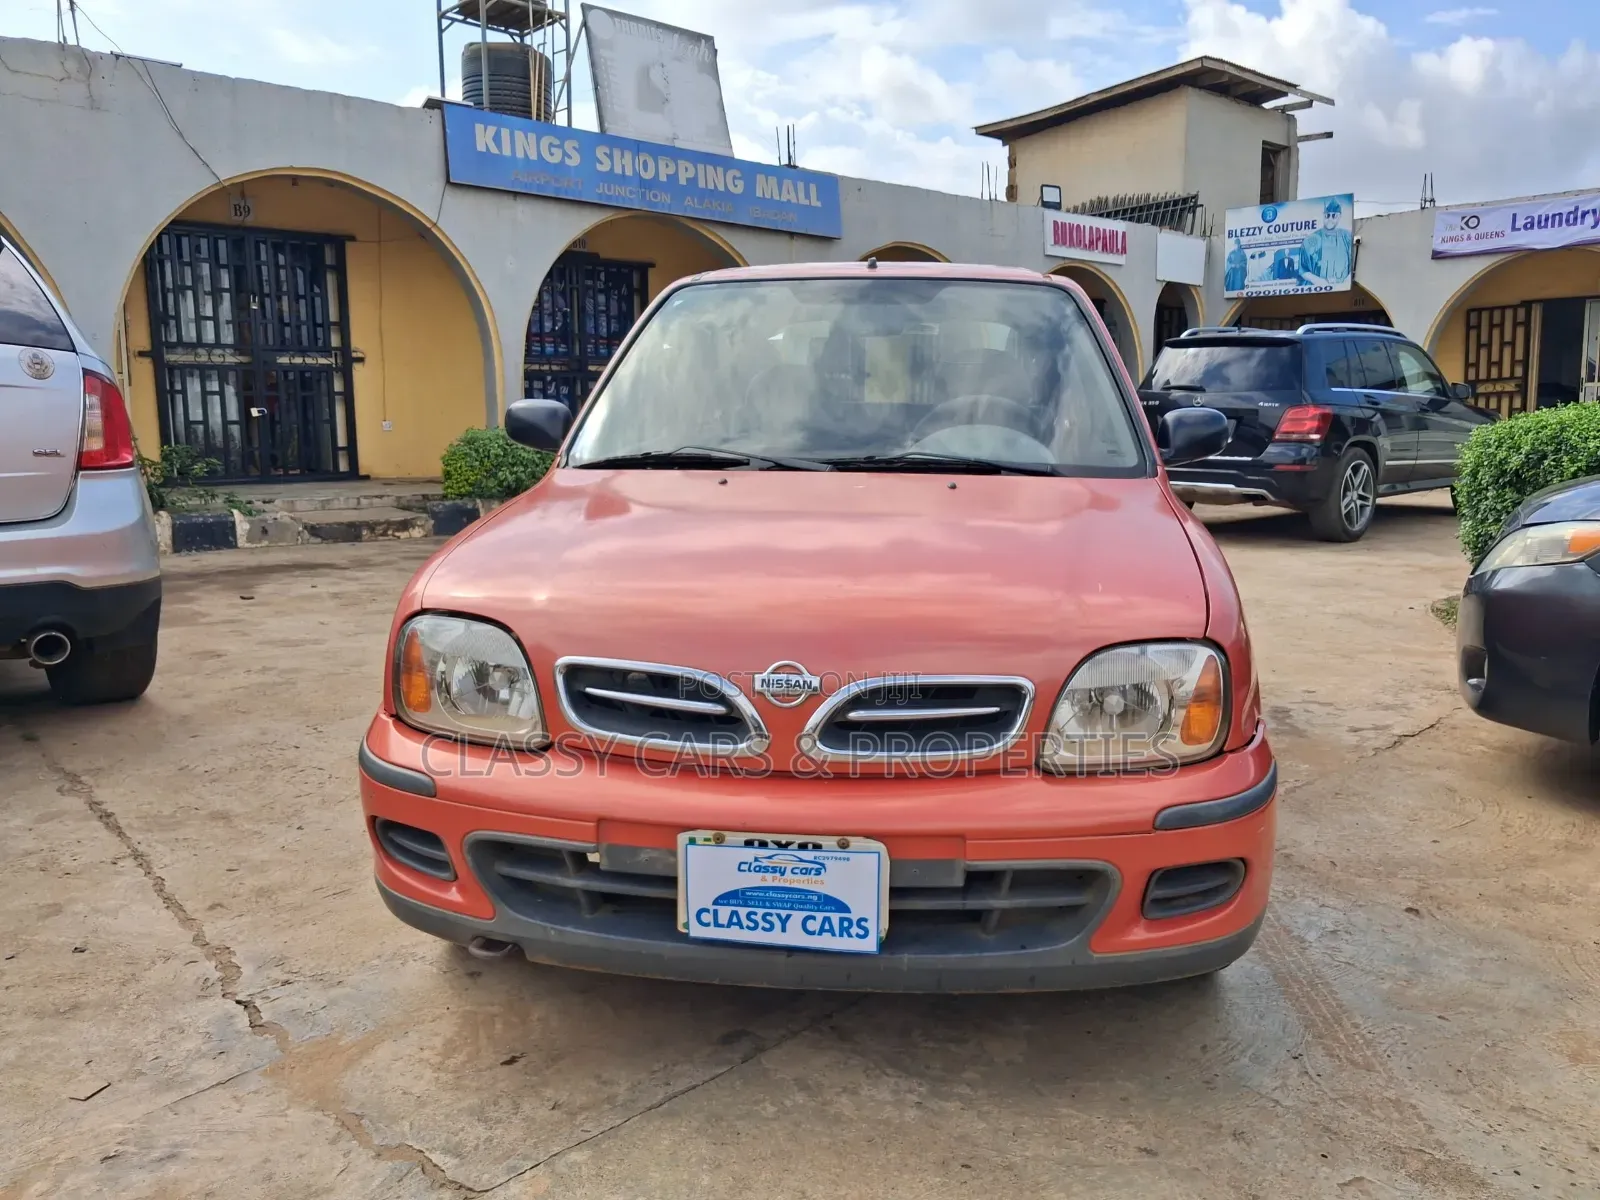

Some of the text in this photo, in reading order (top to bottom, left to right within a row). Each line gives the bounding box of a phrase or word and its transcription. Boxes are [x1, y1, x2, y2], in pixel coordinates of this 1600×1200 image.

[474, 122, 823, 208] KINGS SHOPPING MALL
[512, 170, 584, 191] AIRPORT
[595, 182, 671, 204] JUNCTION
[684, 195, 734, 214] ALAKIA
[233, 203, 251, 218] B9
[1510, 204, 1600, 233] Laundry
[1227, 226, 1264, 239] BLEZZY
[1266, 219, 1318, 234] COUTURE
[1052, 219, 1128, 256] BUKOLAPAULA
[1440, 230, 1506, 244] KINGS & QUEENS
[1245, 285, 1334, 298] 09051691400
[760, 678, 813, 690] NISSAN
[737, 861, 824, 877] Classy cars
[760, 875, 825, 886] & Properties
[745, 890, 819, 901] www.classycars.ng
[793, 903, 818, 911] Quality
[695, 907, 870, 940] CLASSY CARS
